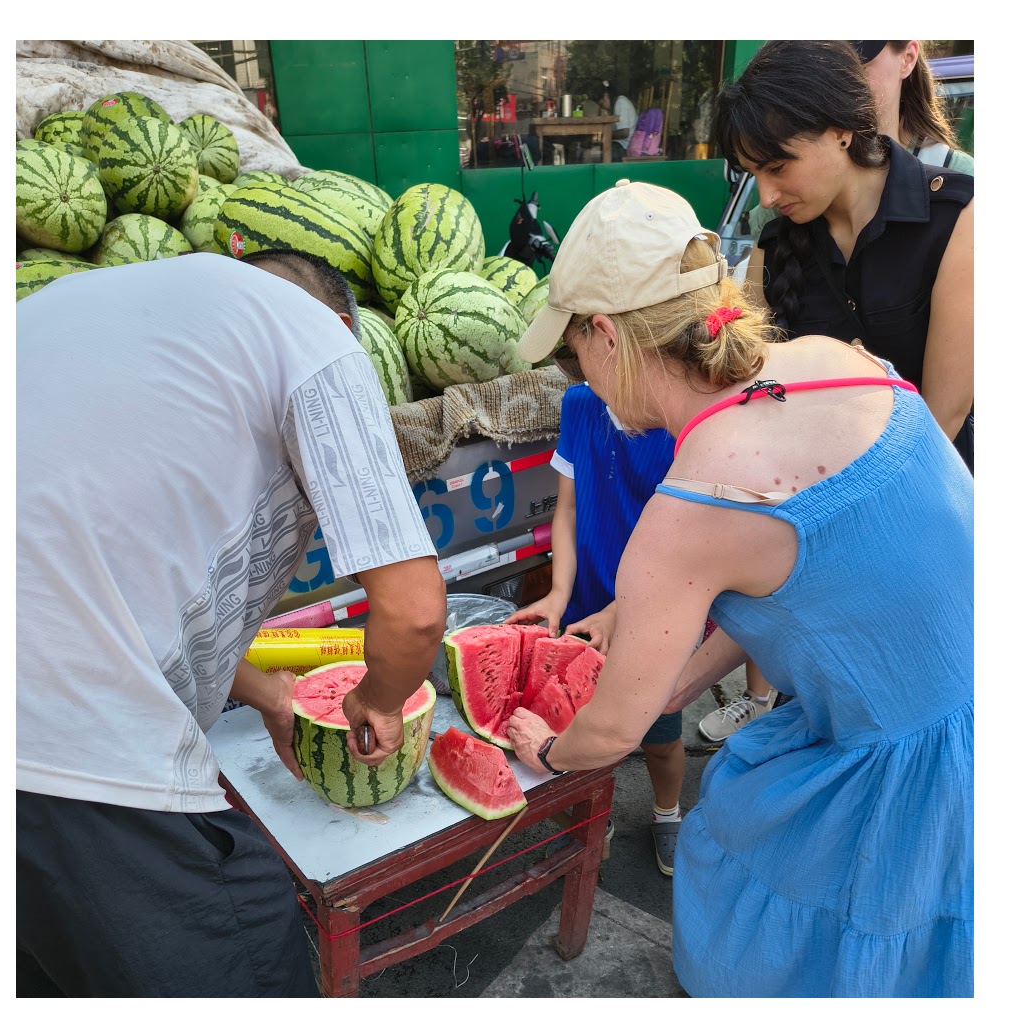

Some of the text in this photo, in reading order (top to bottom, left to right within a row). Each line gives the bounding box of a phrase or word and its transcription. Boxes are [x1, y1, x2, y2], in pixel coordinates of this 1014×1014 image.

[304, 388, 330, 438] LI-NING
[309, 480, 330, 528] LI-NING
[357, 467, 384, 514] LI-NING
